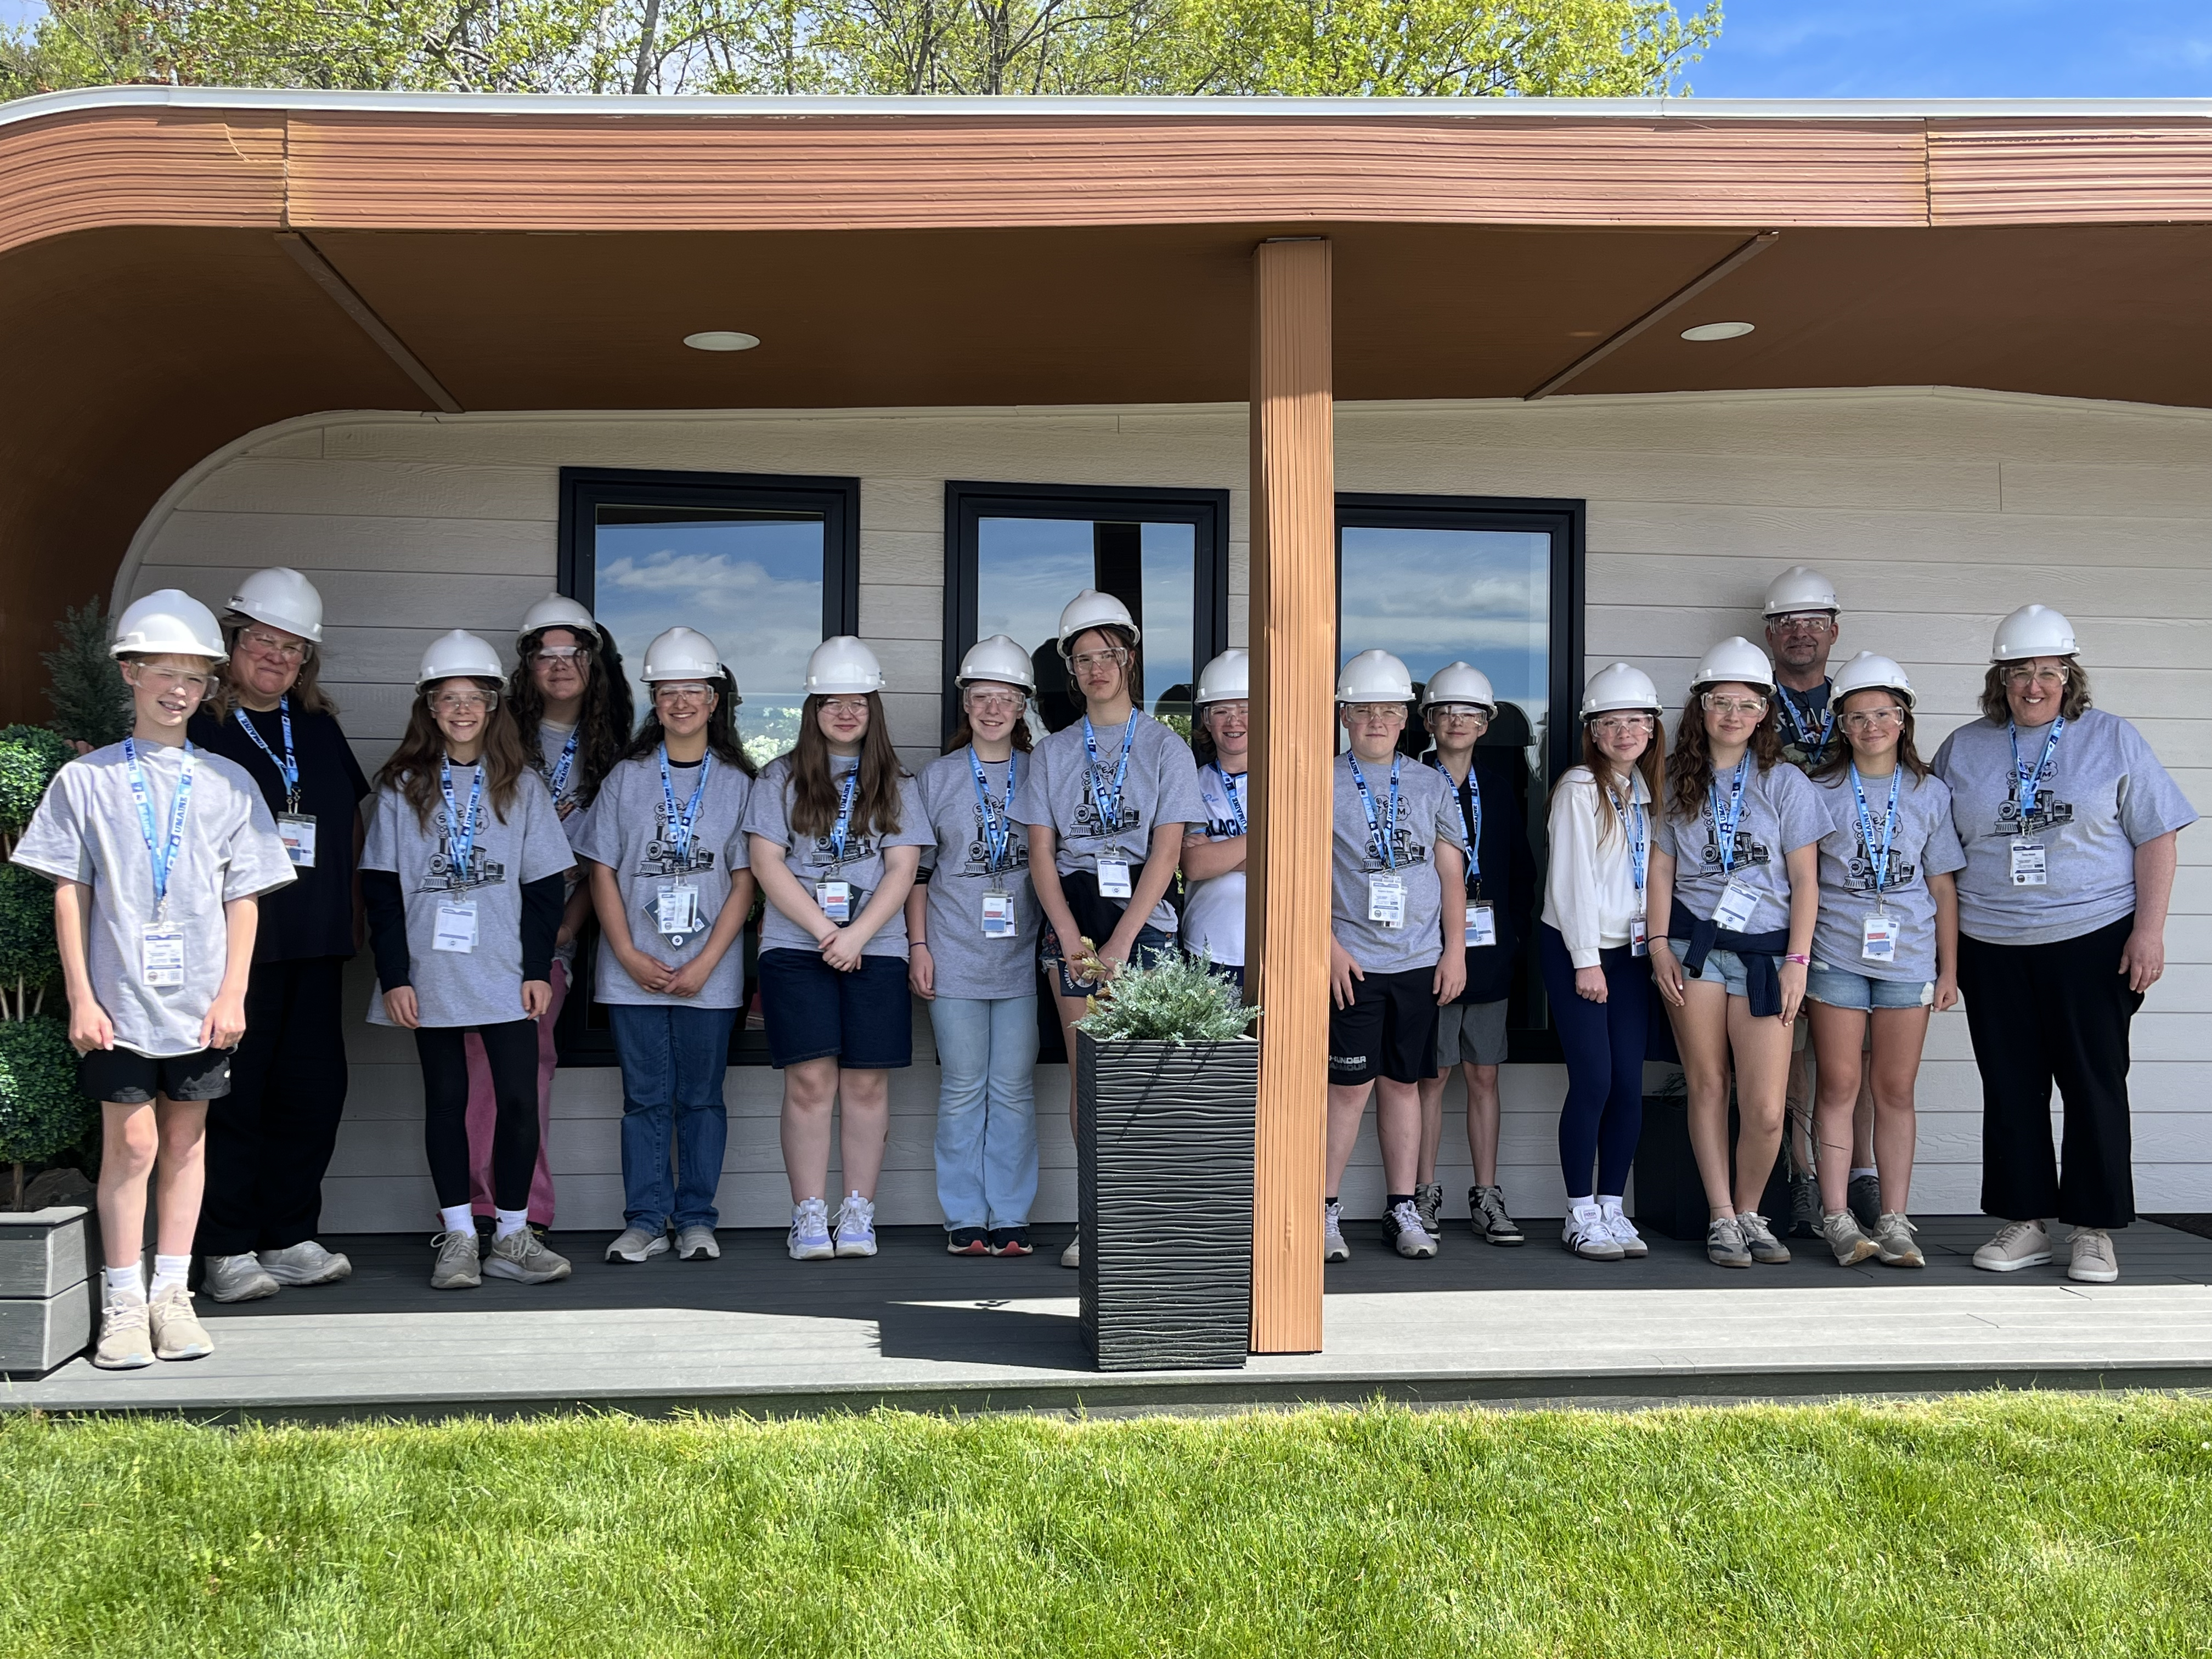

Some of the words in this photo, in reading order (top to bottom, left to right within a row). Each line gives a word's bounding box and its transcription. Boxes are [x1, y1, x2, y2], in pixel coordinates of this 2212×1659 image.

[125, 738, 137, 771] UMAINE
[1347, 752, 1359, 775] UMAINE
[557, 762, 571, 788] UMAINE
[466, 794, 478, 826] UMAINE
[840, 783, 851, 809] UMAINE
[174, 796, 188, 833] UMAINE
[1232, 797, 1247, 826] UMAINE
[1864, 813, 1874, 843] UMAINE
